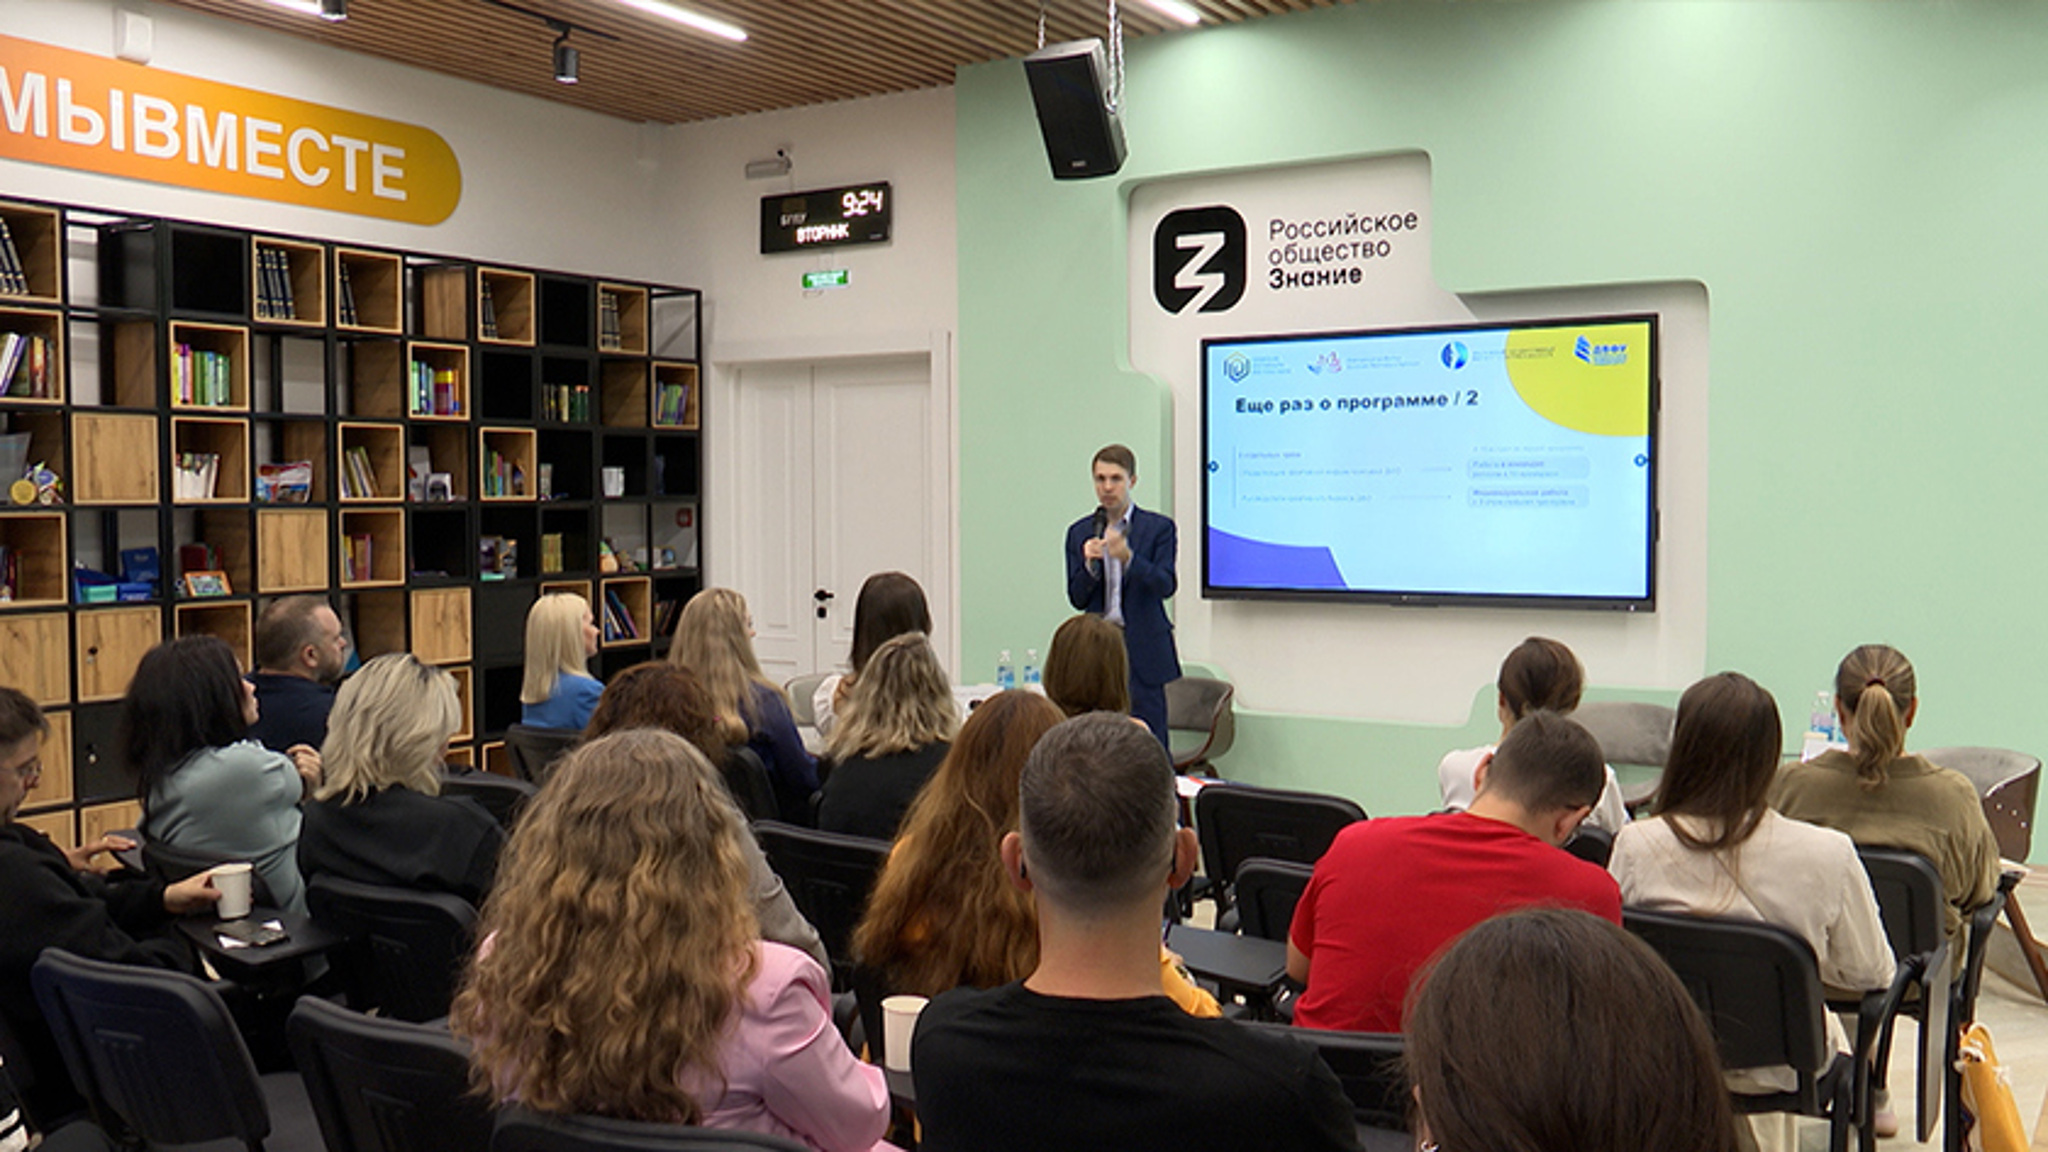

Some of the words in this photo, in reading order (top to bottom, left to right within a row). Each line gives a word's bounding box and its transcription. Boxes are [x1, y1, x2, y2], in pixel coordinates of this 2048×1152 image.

[0, 65, 407, 201] МЫВМЕСТЕ
[842, 189, 883, 218] 9:24
[796, 222, 849, 243] ВТОРНИК
[1269, 211, 1418, 241] Российское
[1269, 239, 1391, 266] общество
[1269, 266, 1363, 290] Знание
[1235, 397, 1274, 415] Еще
[1279, 398, 1314, 415] раз
[1319, 397, 1332, 412] о
[1337, 393, 1449, 414] программе
[1466, 389, 1480, 406] 2
